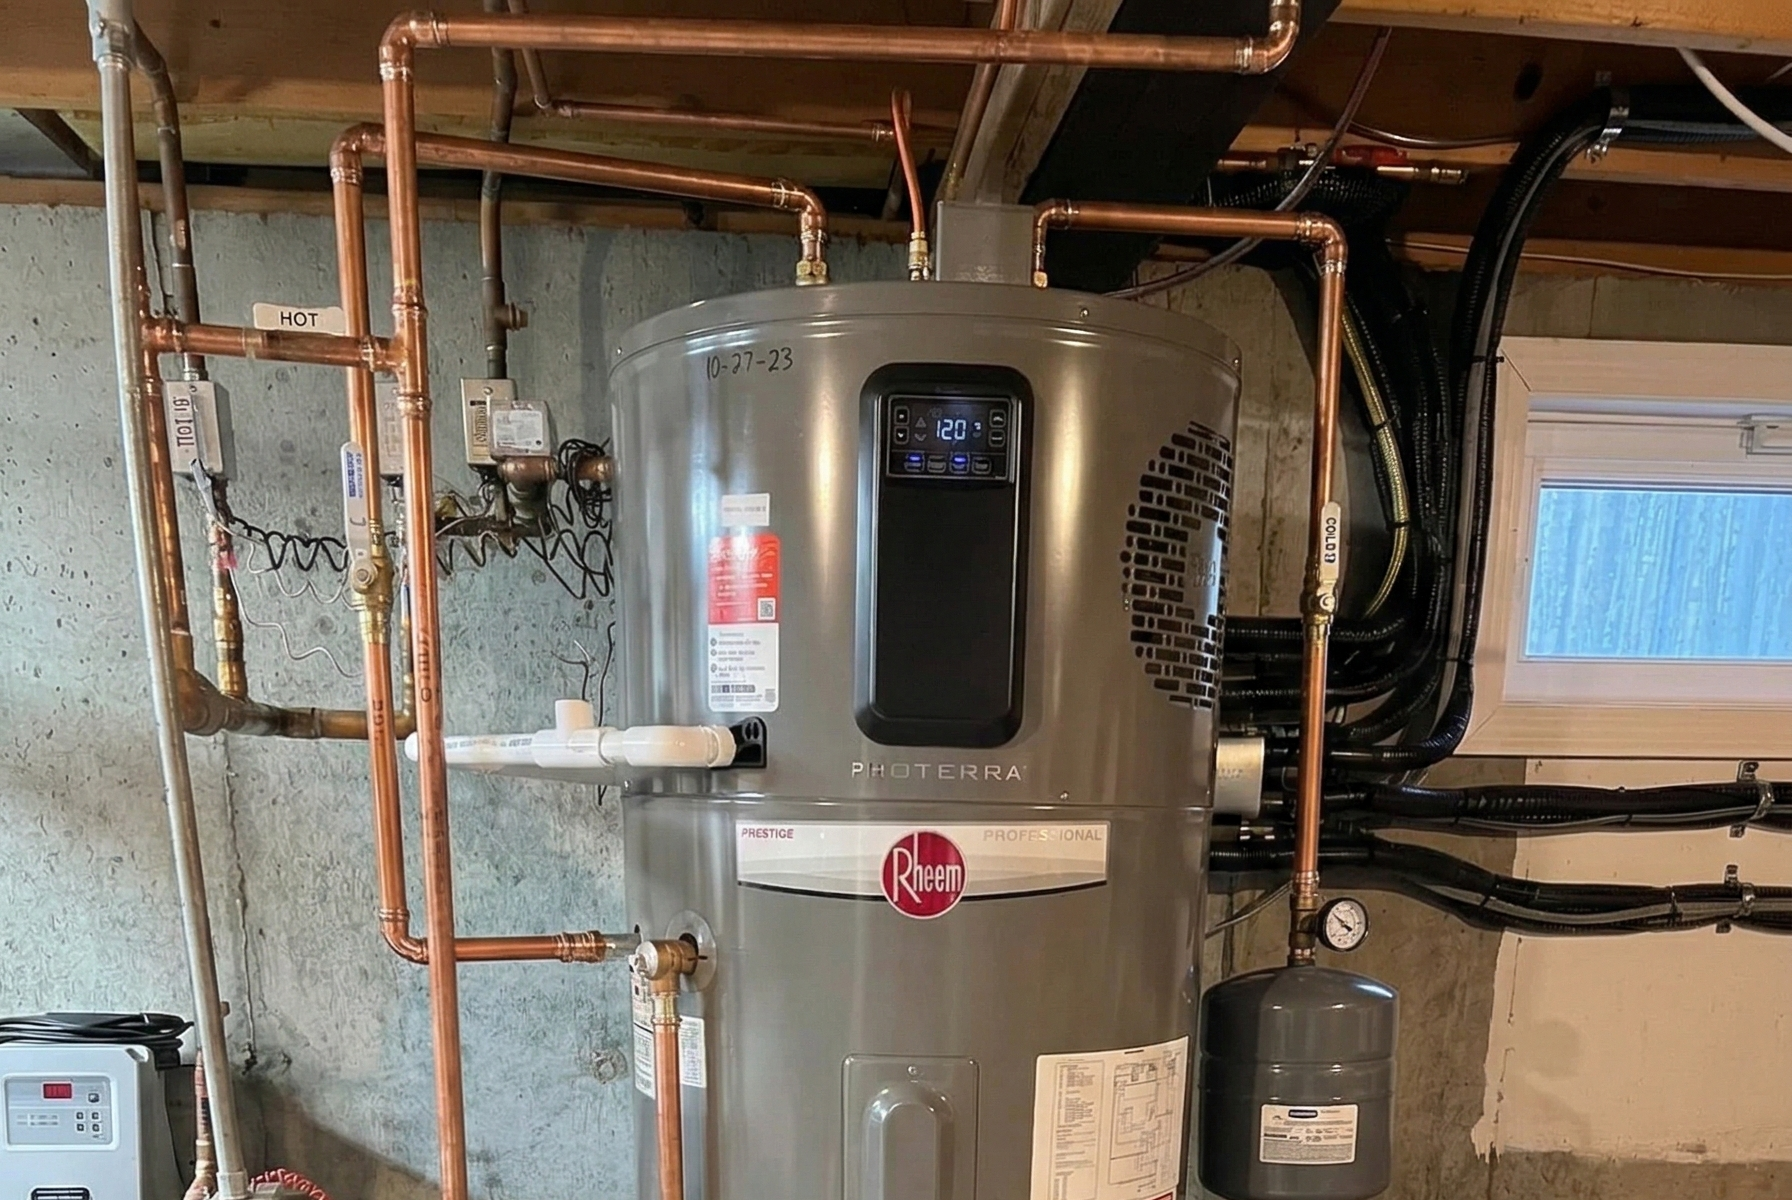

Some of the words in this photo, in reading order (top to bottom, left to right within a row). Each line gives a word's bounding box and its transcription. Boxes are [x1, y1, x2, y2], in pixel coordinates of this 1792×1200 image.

[280, 311, 318, 327] HOT
[706, 347, 794, 381] 10-27-23
[936, 419, 967, 441] 120
[741, 828, 795, 839] PRESTIGE
[892, 832, 962, 904] Rheem
